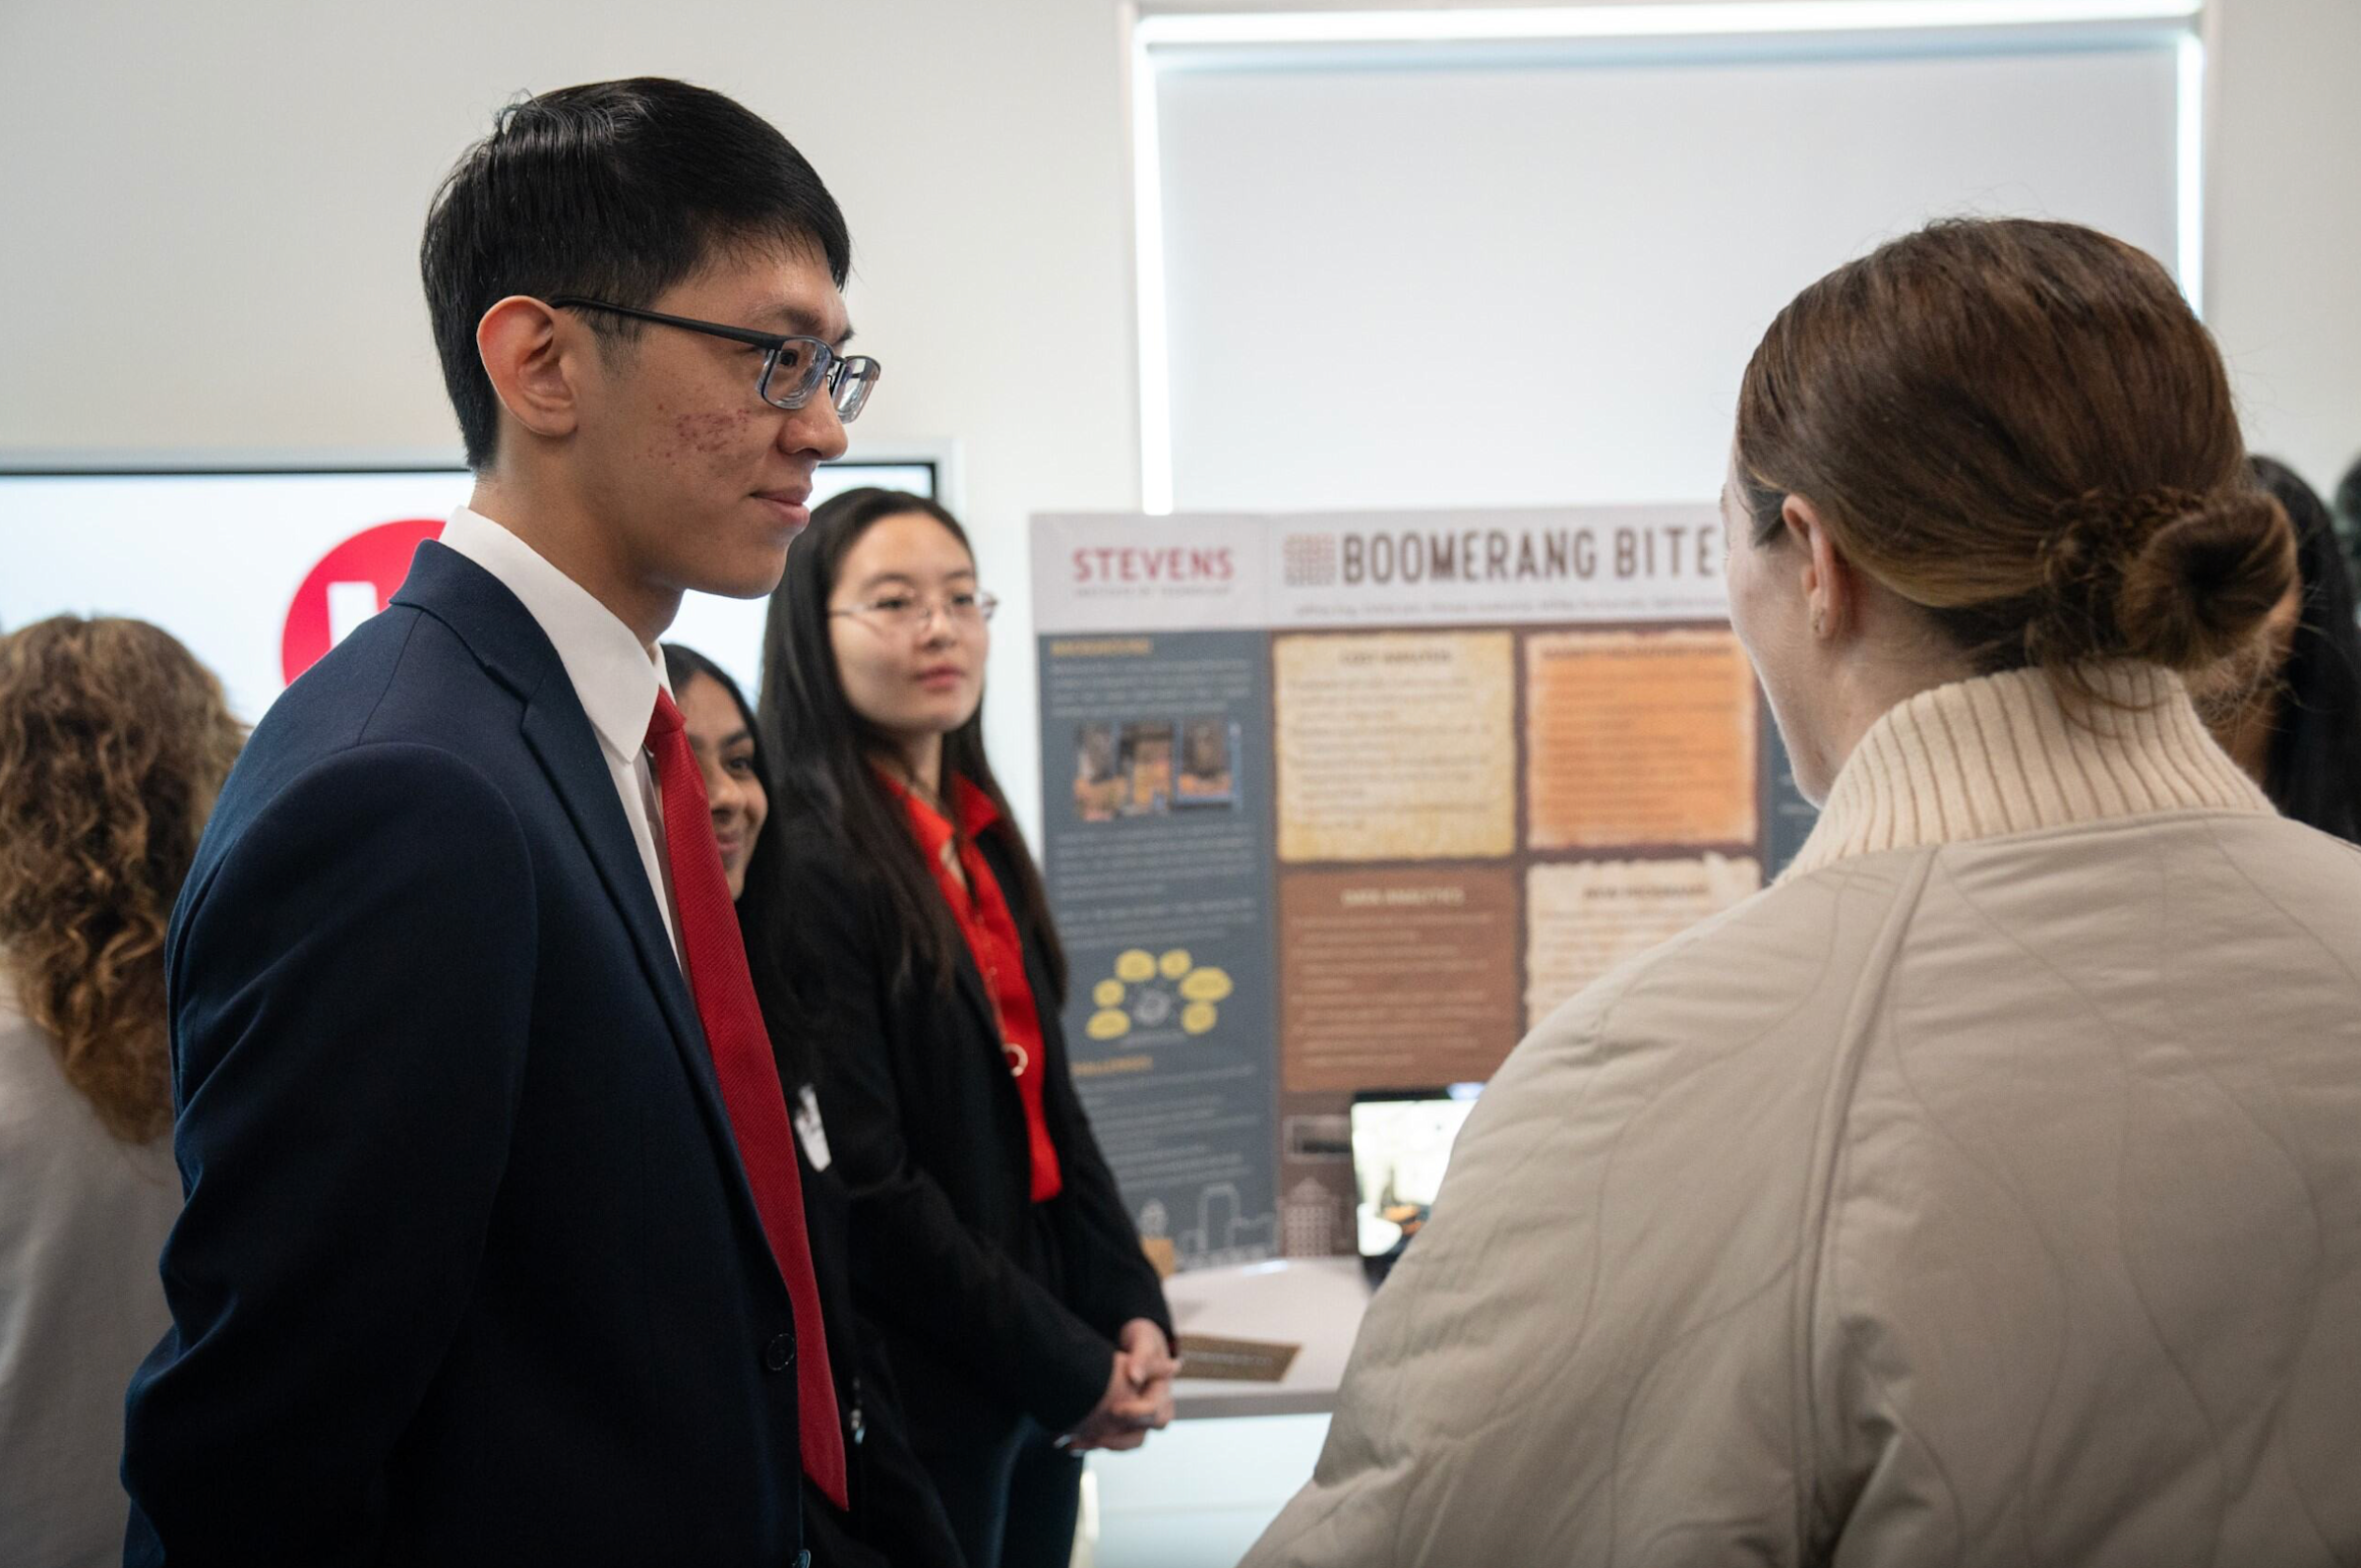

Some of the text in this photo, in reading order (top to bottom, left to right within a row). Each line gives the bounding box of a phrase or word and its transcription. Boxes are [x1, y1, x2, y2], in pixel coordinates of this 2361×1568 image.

[1072, 547, 1234, 583] STEVENS
[1342, 525, 1717, 585] BOOMERANG BITE
